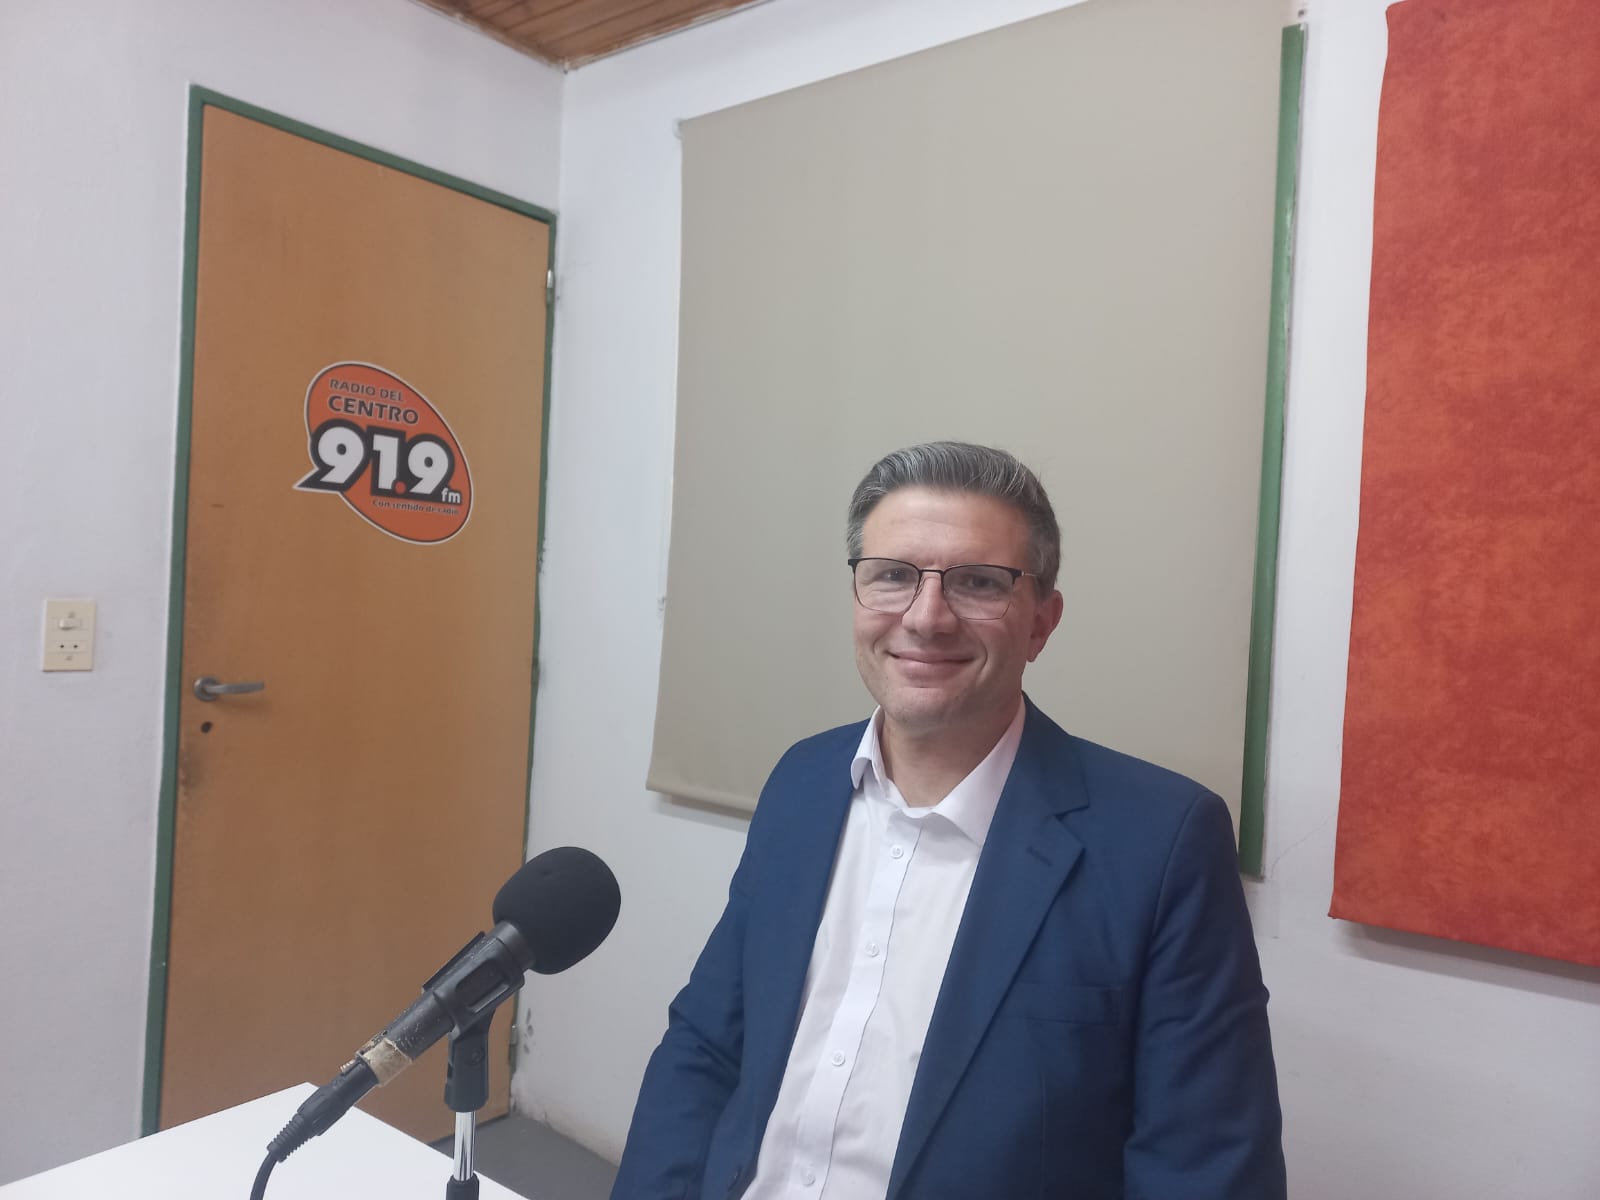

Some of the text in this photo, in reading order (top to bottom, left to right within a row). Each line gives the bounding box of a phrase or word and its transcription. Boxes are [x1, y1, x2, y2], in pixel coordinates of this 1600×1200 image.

[329, 378, 403, 401] RADIO DEL
[328, 395, 419, 425] CENTRO
[317, 426, 461, 504] 91.9 fm
